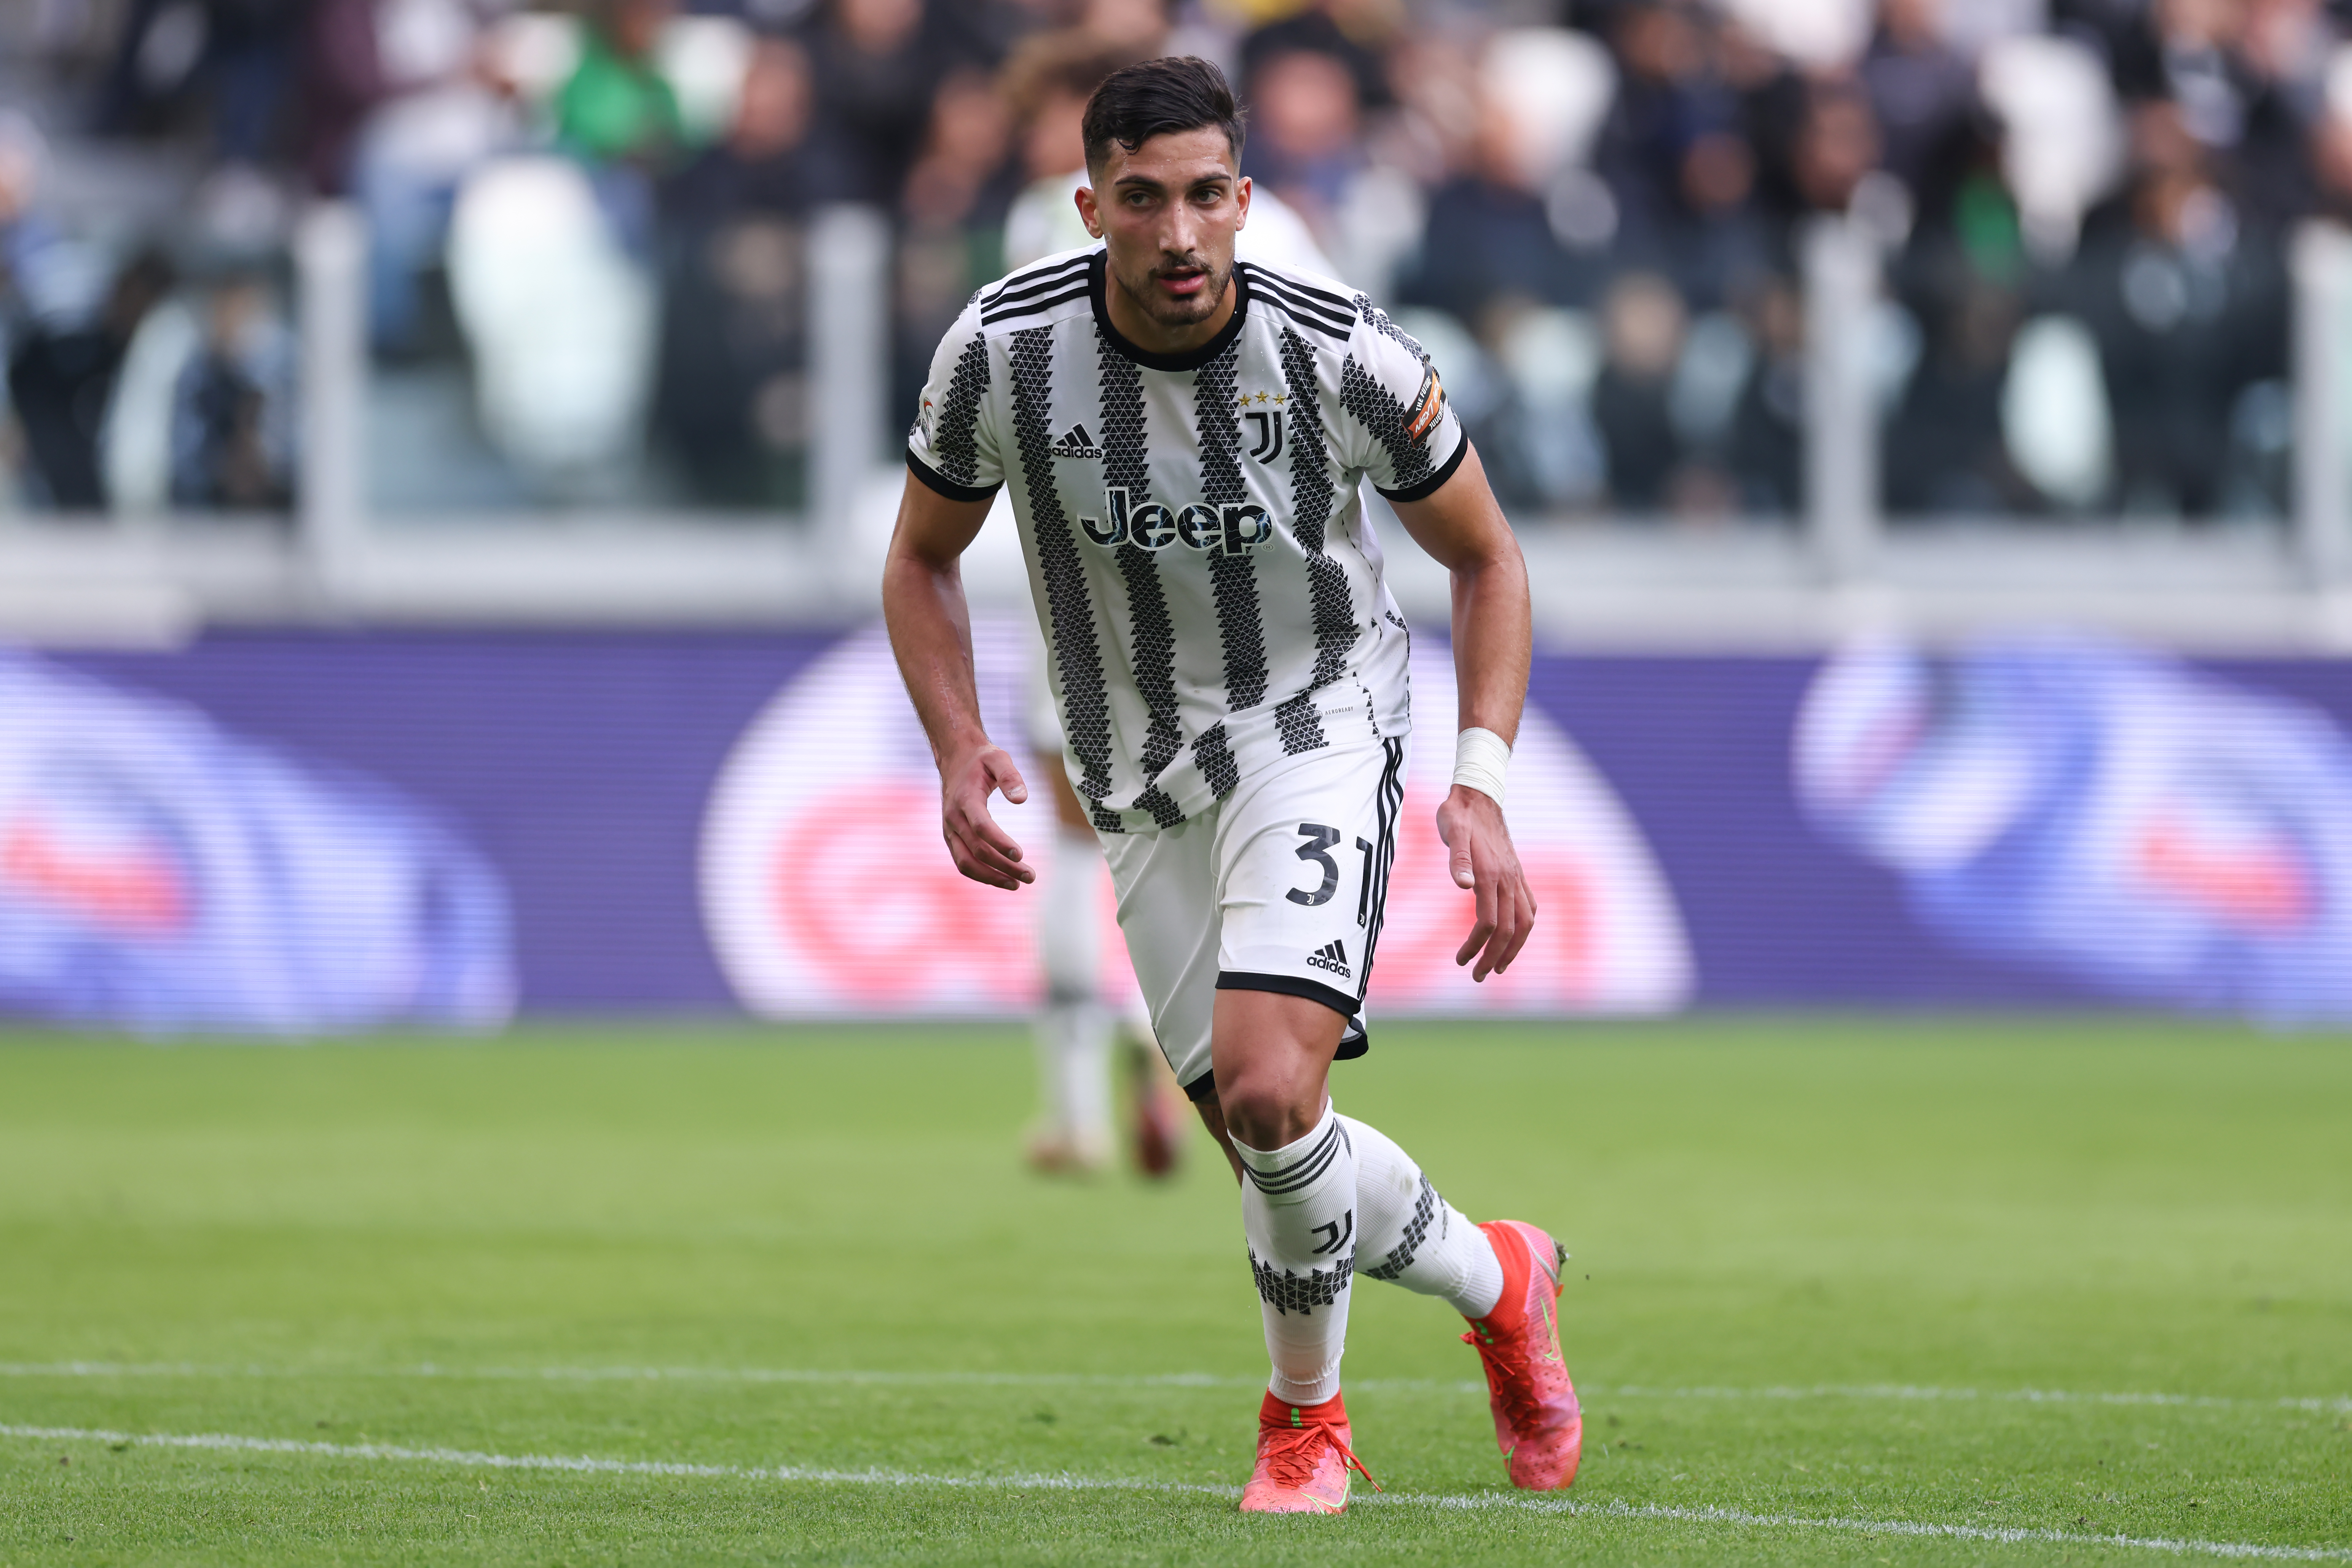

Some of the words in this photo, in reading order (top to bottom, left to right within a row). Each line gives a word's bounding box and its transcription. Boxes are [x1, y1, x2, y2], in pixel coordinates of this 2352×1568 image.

[1420, 375, 1432, 397] FUTURE
[1415, 399, 1434, 433] NEXT
[1052, 446, 1103, 458] adidas
[1078, 487, 1274, 556] Jeep
[1325, 706, 1353, 715] AEROREADY
[1285, 823, 1373, 929] 31
[1306, 956, 1351, 978] adidas
